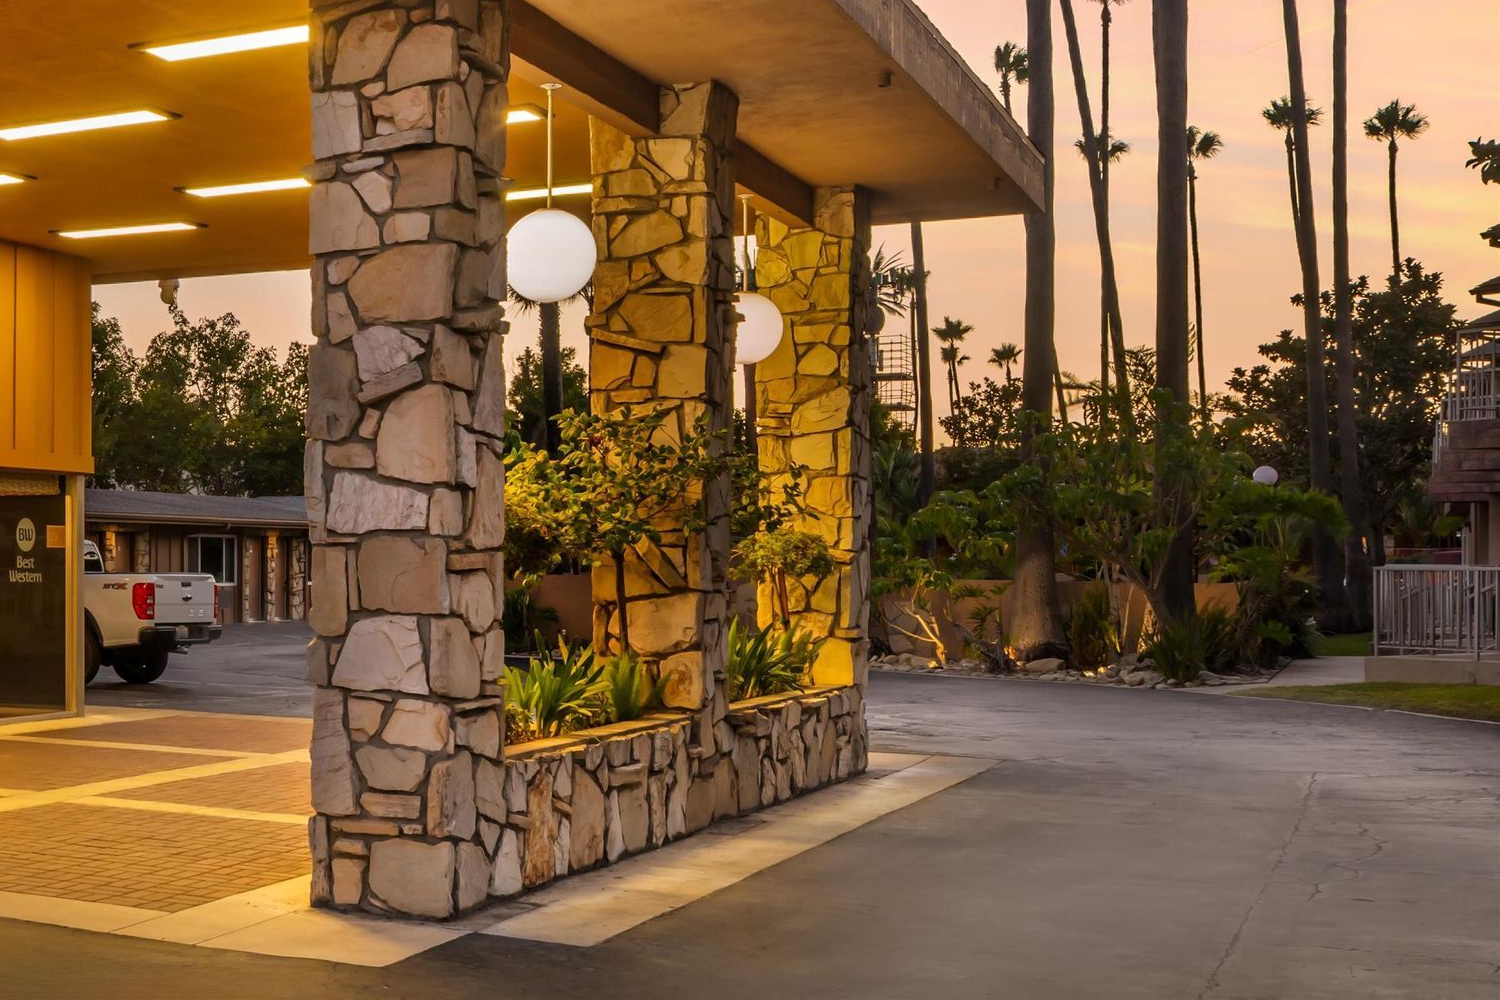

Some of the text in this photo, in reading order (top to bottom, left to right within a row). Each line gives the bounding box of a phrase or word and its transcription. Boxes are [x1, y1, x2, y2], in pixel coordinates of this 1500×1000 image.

[18, 528, 33, 541] BW
[16, 556, 35, 569] Best
[9, 570, 42, 582] Western
